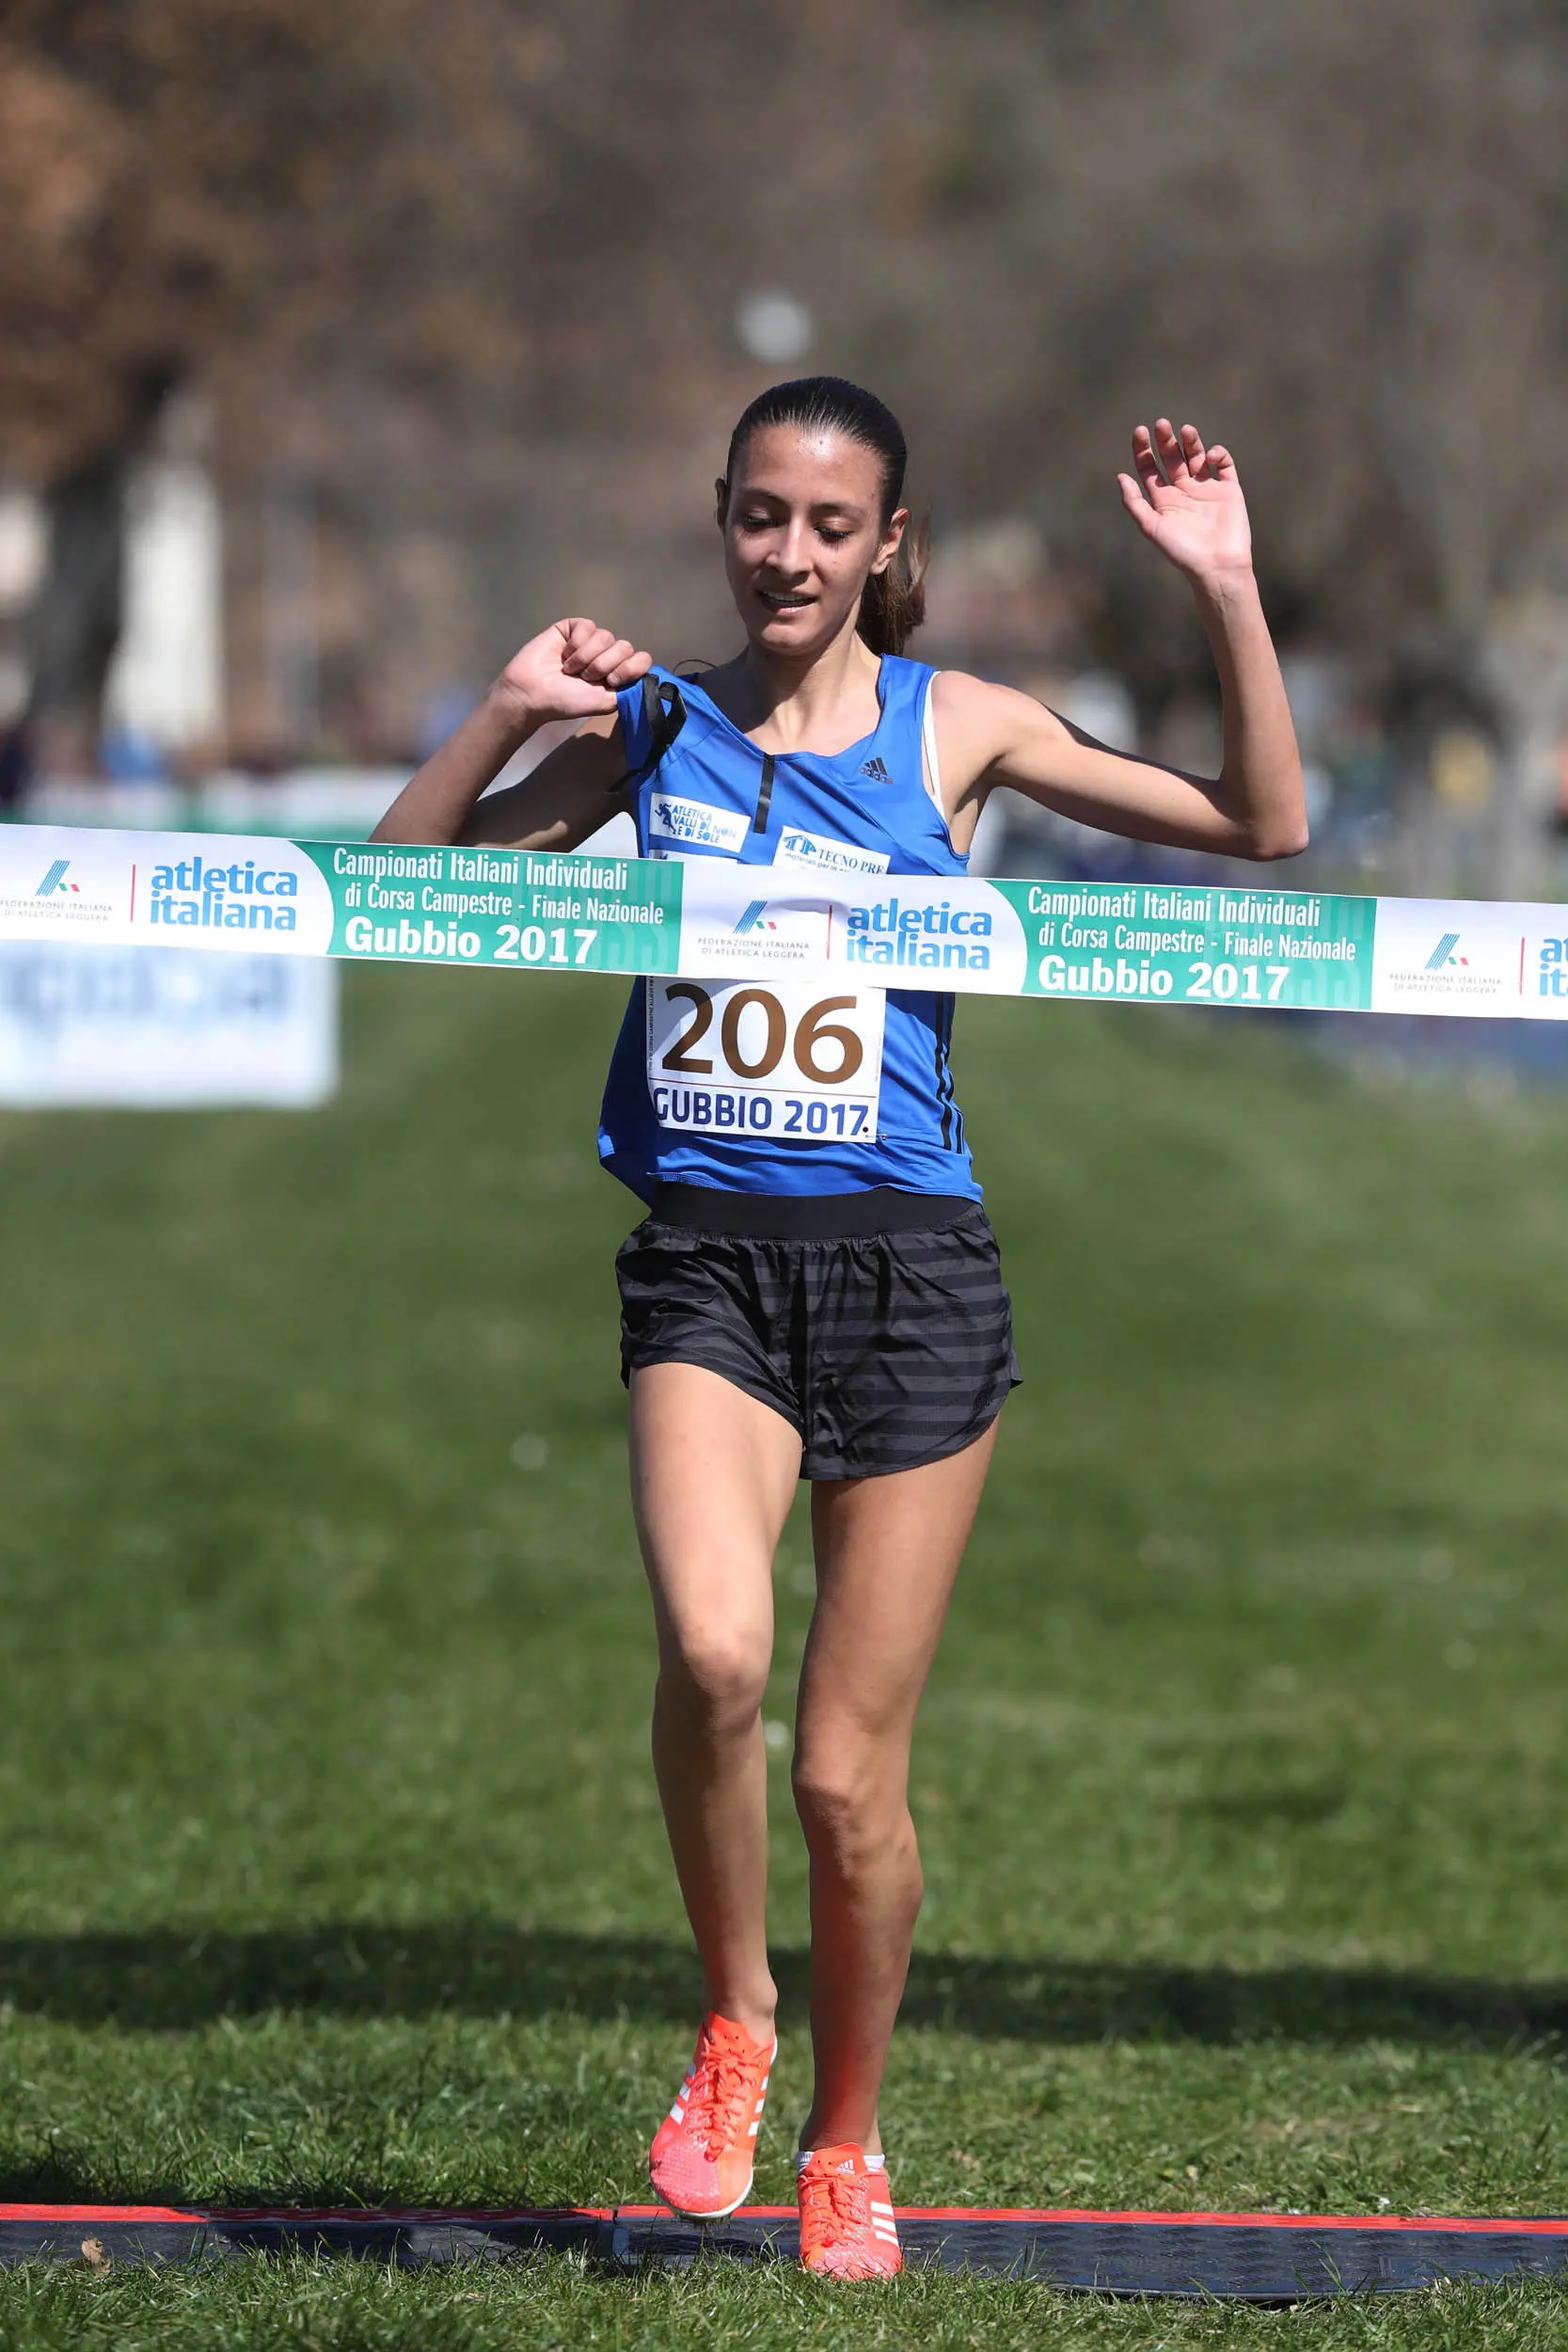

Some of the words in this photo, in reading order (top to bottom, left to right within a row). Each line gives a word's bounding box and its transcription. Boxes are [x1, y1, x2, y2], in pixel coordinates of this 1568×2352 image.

[859, 768, 894, 785] adidas
[672, 805, 713, 821] ATLETICA
[673, 815, 696, 828] VALLI
[700, 821, 710, 831] DI
[712, 824, 737, 838] NON
[677, 827, 683, 835] E
[685, 828, 694, 837] DI
[696, 830, 720, 843] SOLE
[150, 856, 298, 897] atletica
[333, 848, 443, 883] Campionati
[450, 852, 518, 885] Italiani
[526, 857, 627, 891] Individuali
[818, 848, 858, 869] TECNO
[0, 899, 65, 911] FEDERAZIONE
[70, 903, 113, 912] ITALIANA
[18, 911, 62, 919] ATLETICA
[150, 888, 296, 931] italiana
[344, 882, 360, 908] di
[368, 883, 415, 911] Corsa
[421, 886, 513, 919] Campestre
[532, 894, 580, 919] Finale
[586, 895, 664, 925] Nazionale
[847, 898, 992, 936] atletica
[1028, 886, 1136, 922] Campionati
[1143, 891, 1212, 923] Italiani
[1219, 895, 1320, 927] Individuali
[345, 915, 481, 958] Gubbio
[493, 923, 597, 964] 2017
[698, 937, 764, 947] FEDERAZIONE
[767, 941, 810, 949] ITALIANA
[714, 948, 760, 957] ATLETICA
[847, 929, 990, 971] italiana
[1038, 925, 1054, 948] di
[1061, 925, 1108, 950] Corsa
[1115, 926, 1205, 958] Campestre
[1225, 932, 1274, 958] Finale
[1278, 935, 1356, 962] Nazionale
[1037, 954, 1173, 996] Gubbio
[1184, 961, 1290, 1002] 2017
[1389, 974, 1454, 983] FEDERAZIONE
[1458, 977, 1502, 986] ITALIANA
[661, 982, 863, 1085] 206
[653, 1088, 772, 1130] GUBBIO
[784, 1100, 869, 1136] 2017
